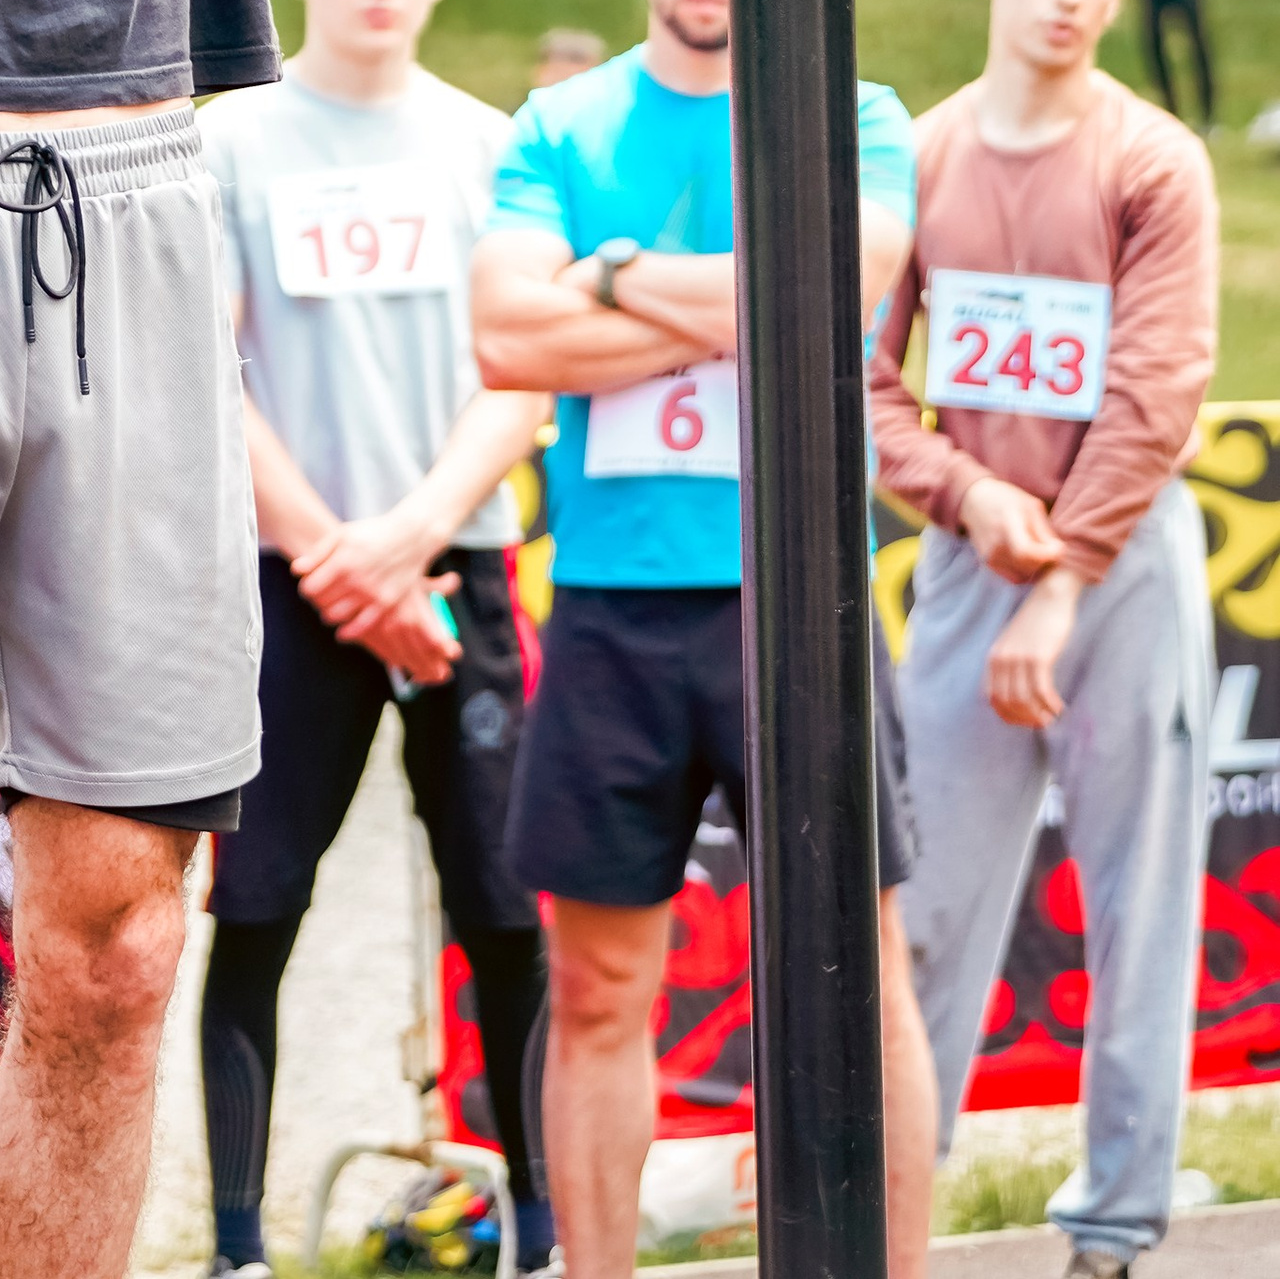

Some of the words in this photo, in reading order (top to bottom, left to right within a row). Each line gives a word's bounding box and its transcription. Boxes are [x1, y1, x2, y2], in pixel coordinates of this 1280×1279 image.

[299, 216, 426, 278] 197
[952, 325, 1085, 396] 243
[659, 381, 704, 451] 6
